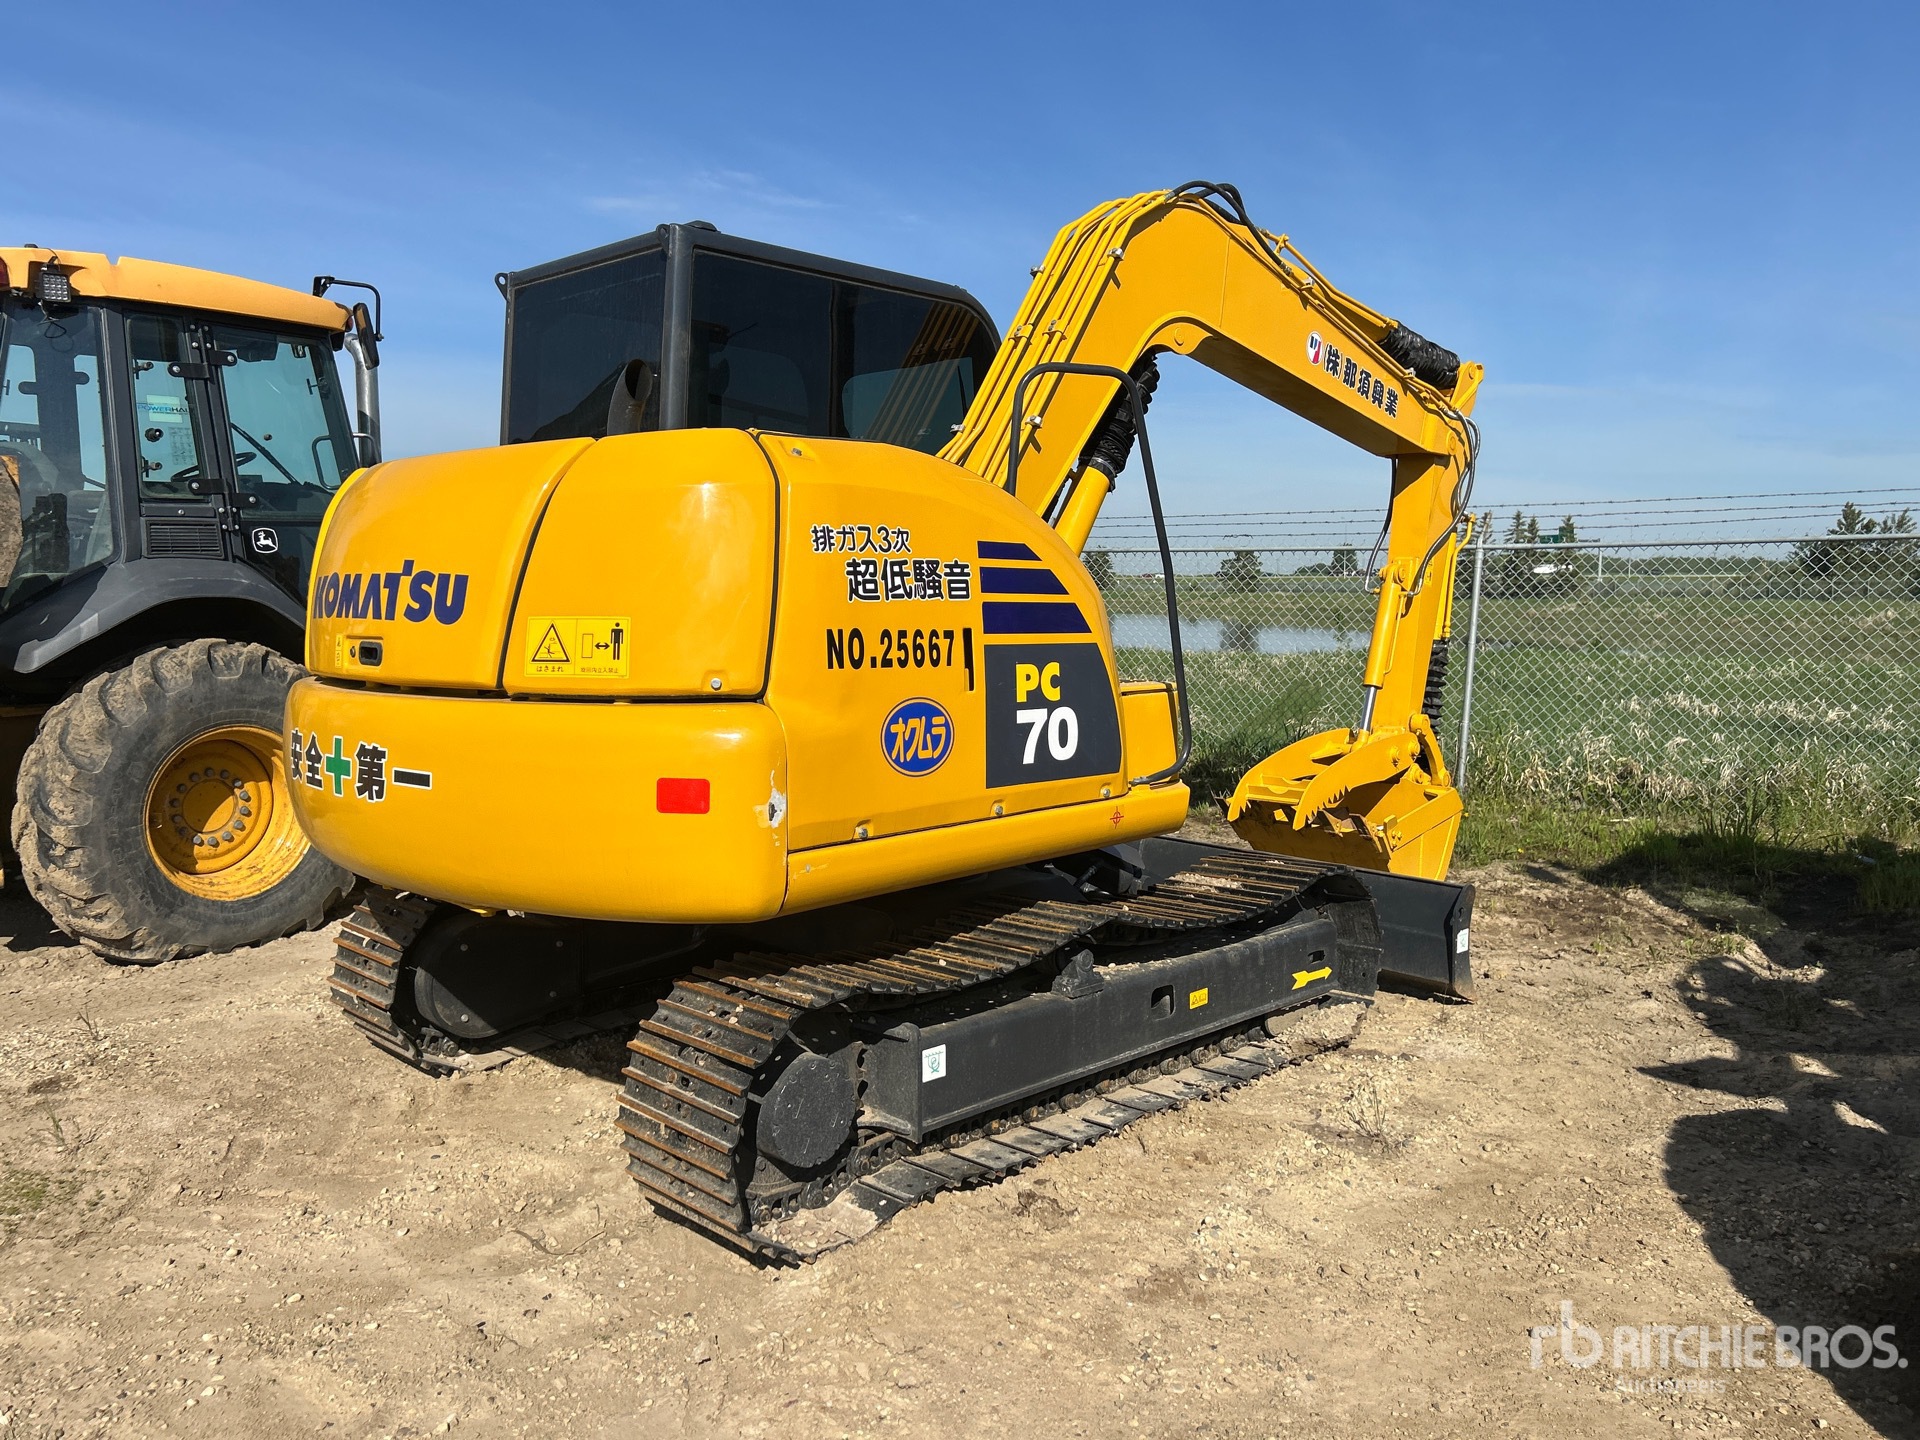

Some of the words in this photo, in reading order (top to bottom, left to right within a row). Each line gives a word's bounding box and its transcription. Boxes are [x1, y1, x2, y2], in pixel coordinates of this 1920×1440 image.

[811, 525, 911, 554] 排ガス3次
[314, 559, 469, 625] KOMATSU
[1015, 662, 1061, 703] PC
[890, 715, 946, 763] オクムラ
[1015, 706, 1079, 765] 70
